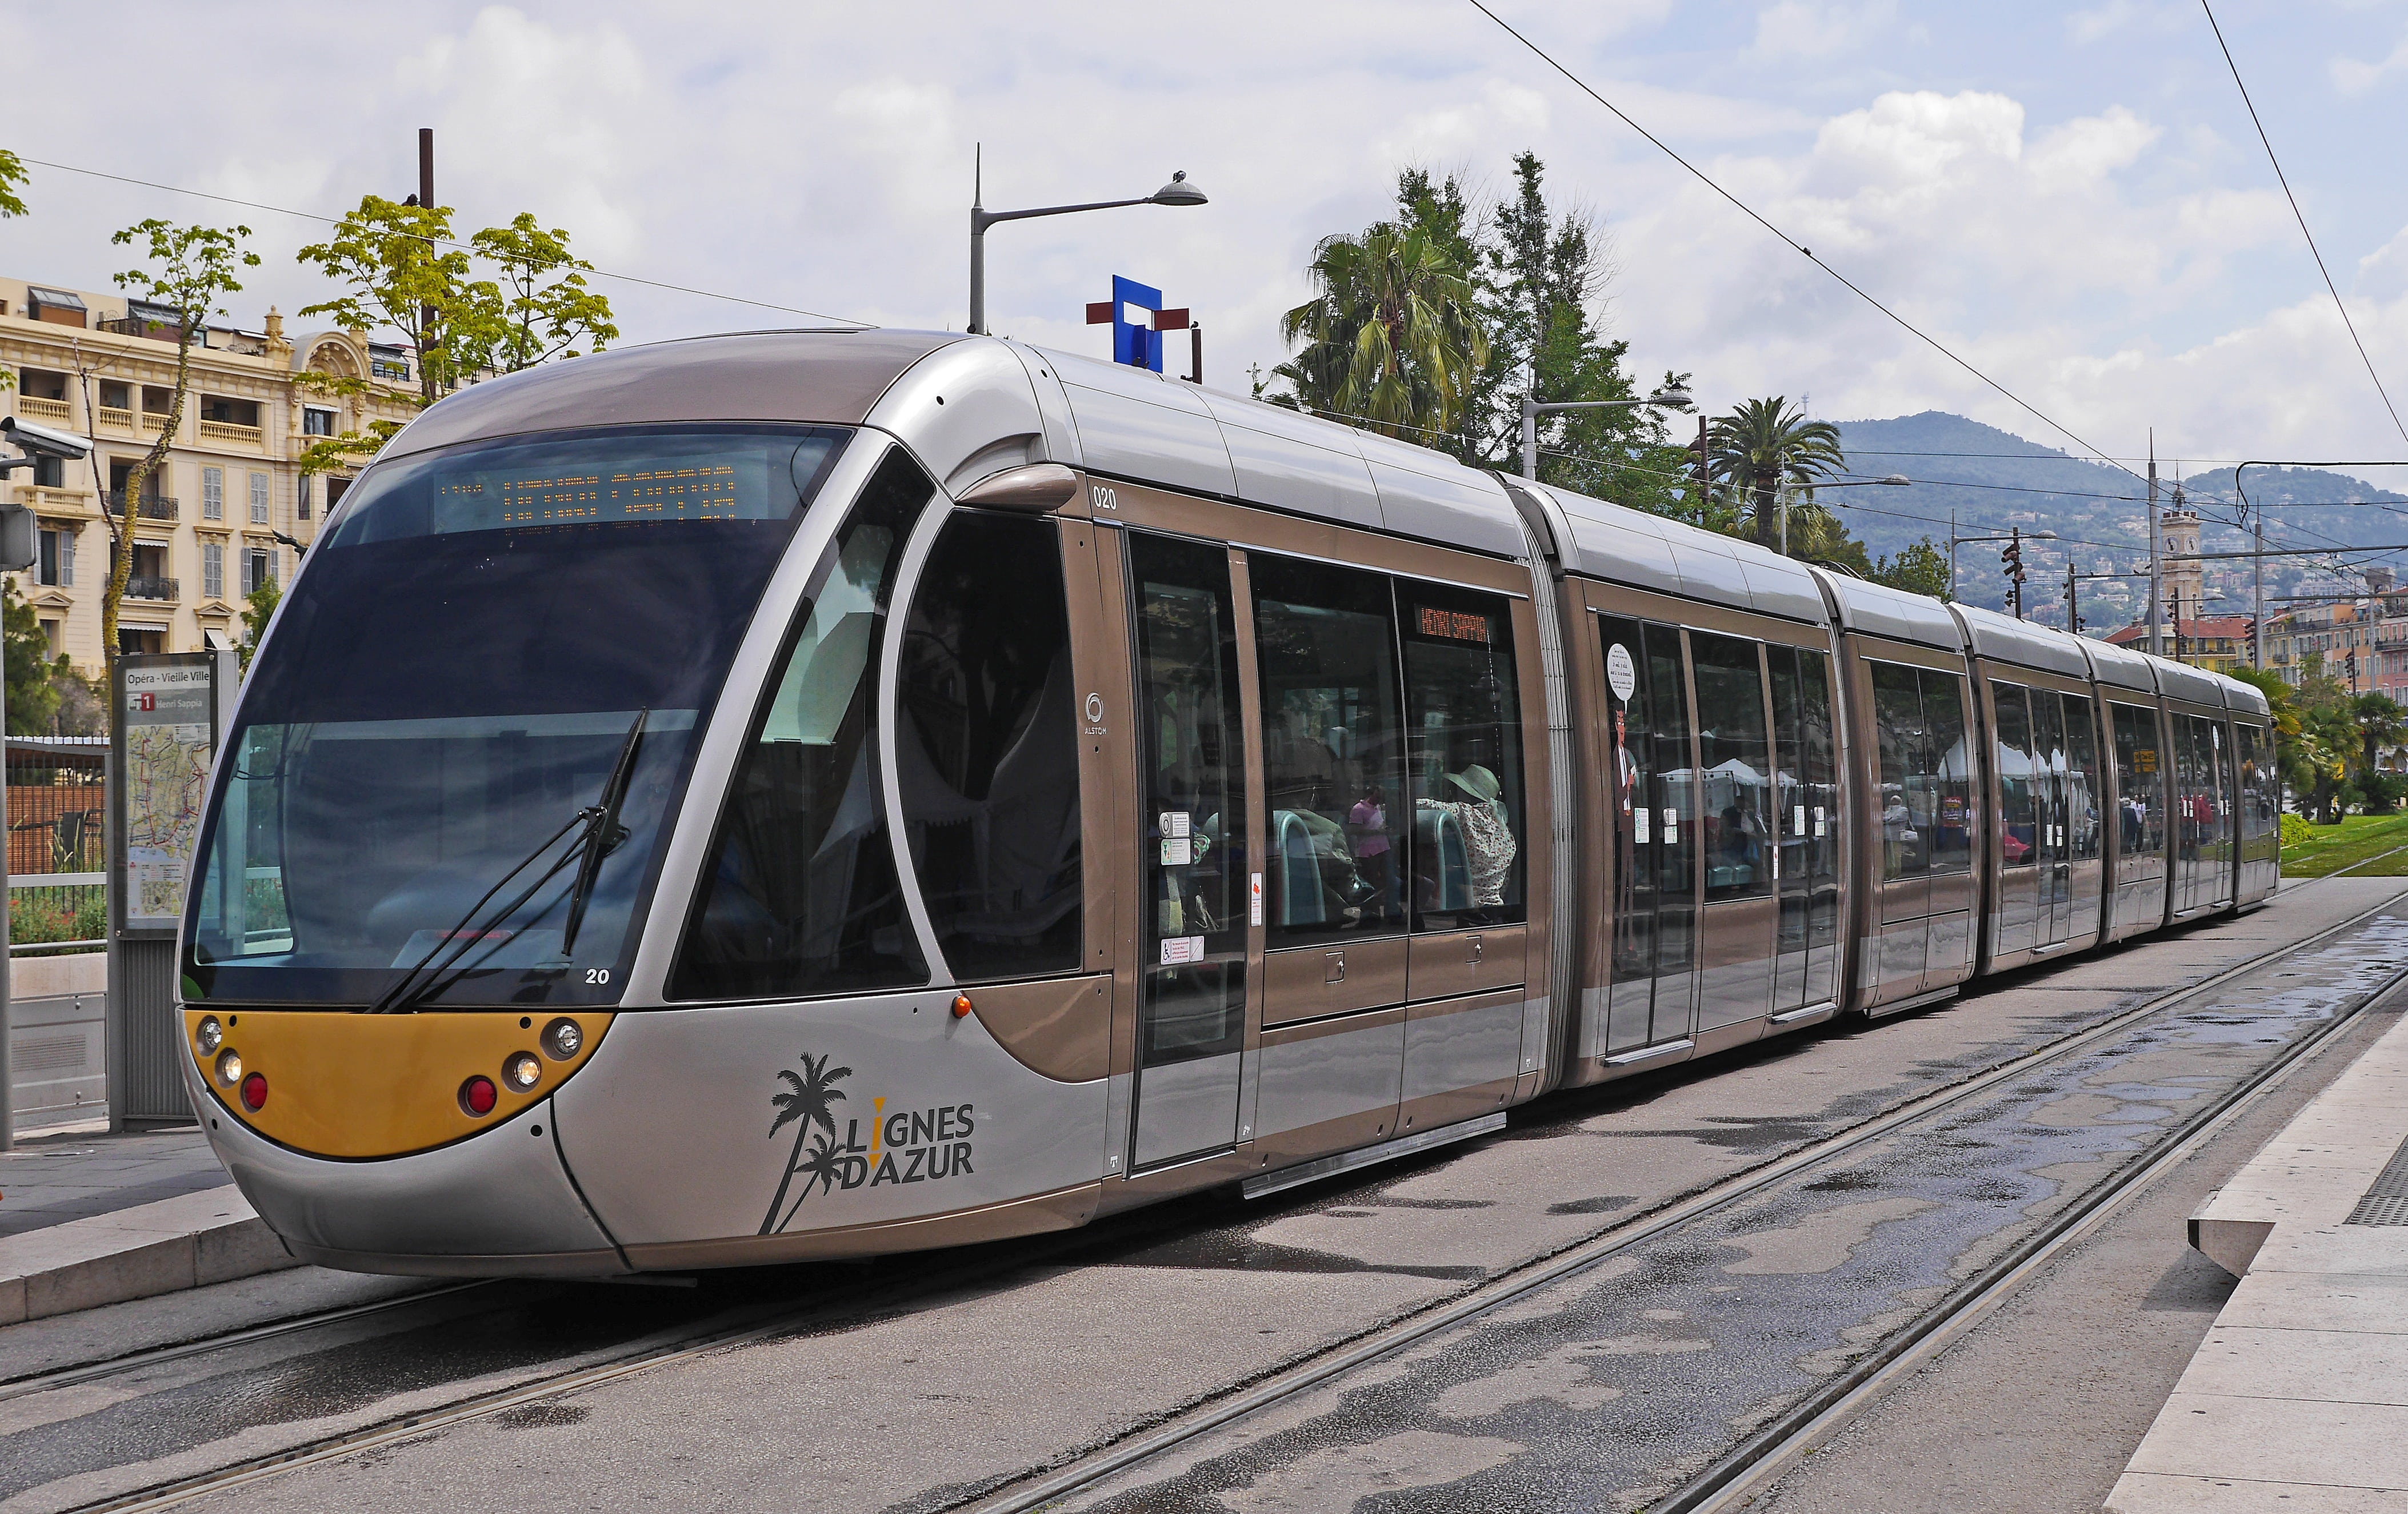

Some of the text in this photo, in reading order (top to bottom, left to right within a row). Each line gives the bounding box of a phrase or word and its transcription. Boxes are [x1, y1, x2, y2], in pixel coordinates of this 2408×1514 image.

[1093, 486, 1117, 510] 020
[1421, 608, 1486, 642] HENRI SAPPIA
[127, 673, 154, 686] Opéra
[161, 672, 189, 682] Vieille
[190, 671, 209, 681] Ville
[144, 696, 203, 709] 1 Henri Sappia
[1085, 726, 1107, 736] ALSTOM
[585, 968, 610, 984] 20
